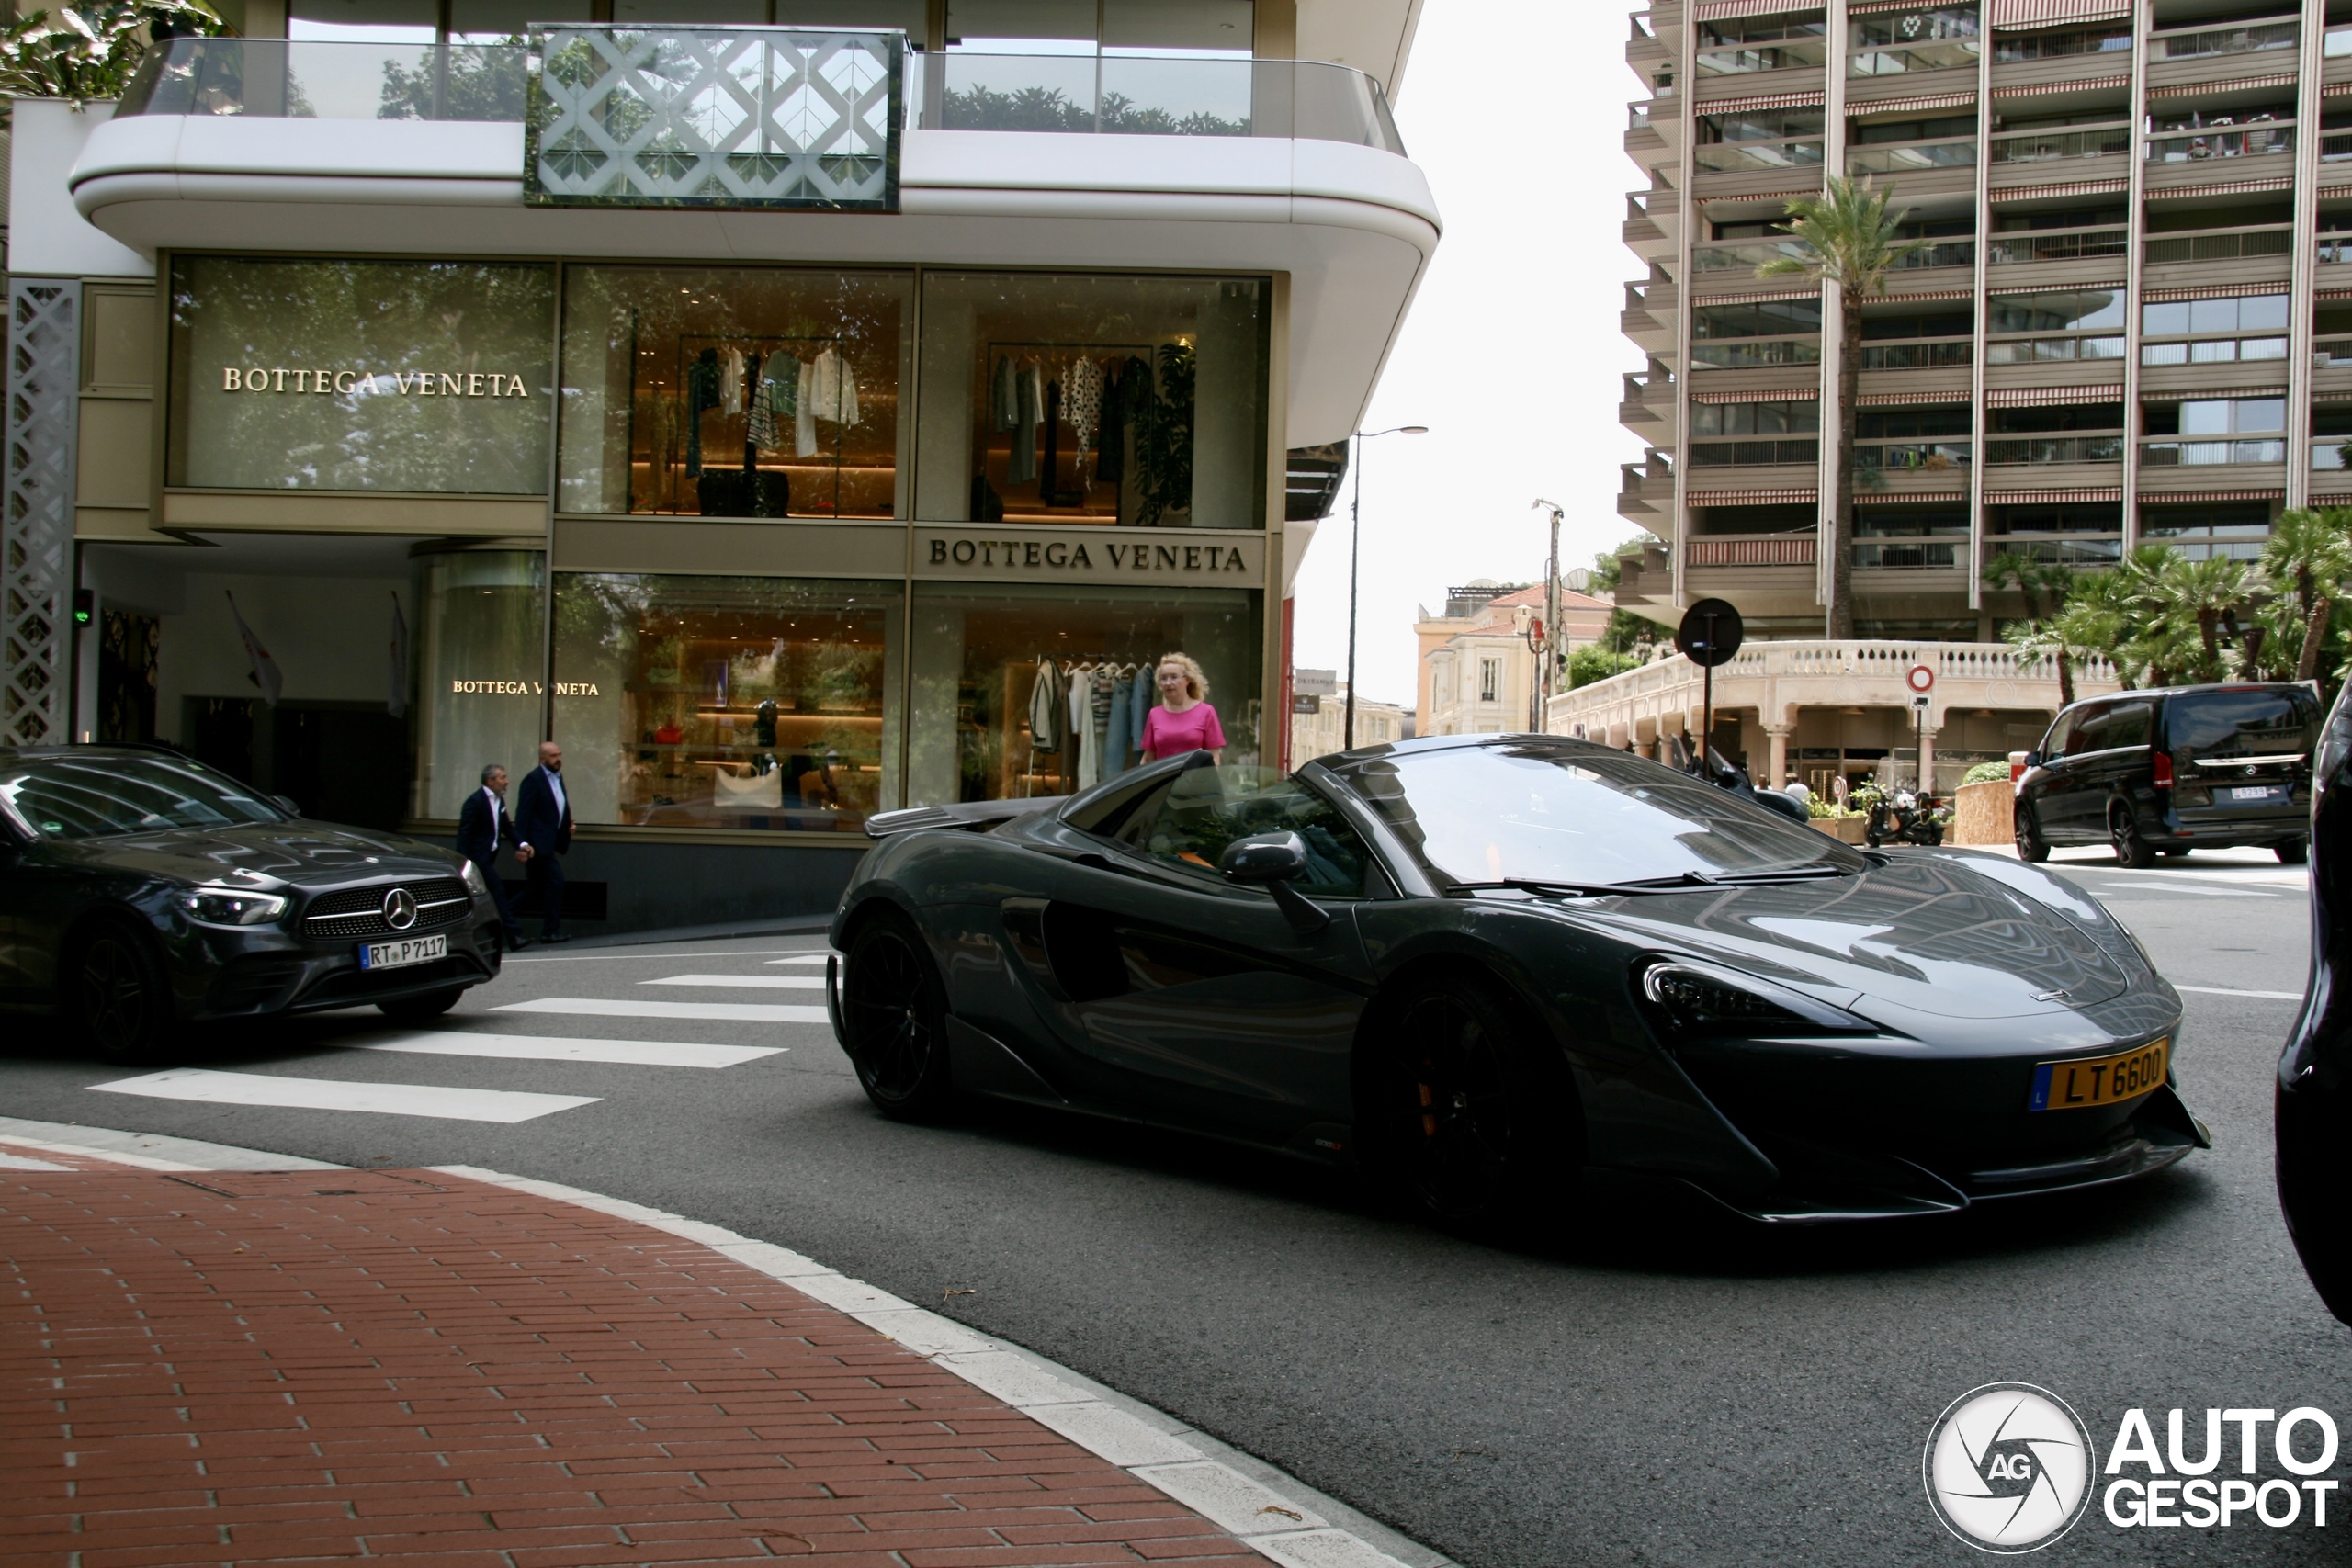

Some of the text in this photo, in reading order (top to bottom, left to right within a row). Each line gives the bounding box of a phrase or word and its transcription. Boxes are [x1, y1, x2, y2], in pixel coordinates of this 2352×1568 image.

[222, 367, 528, 398] BOTTEGA VENETA
[928, 538, 1248, 571] BOTTEGA VENETA
[453, 680, 600, 696] BOTTEGA VNETA
[370, 944, 391, 965] RT
[413, 936, 445, 959] 7117
[2065, 1047, 2162, 1103] LT 6600
